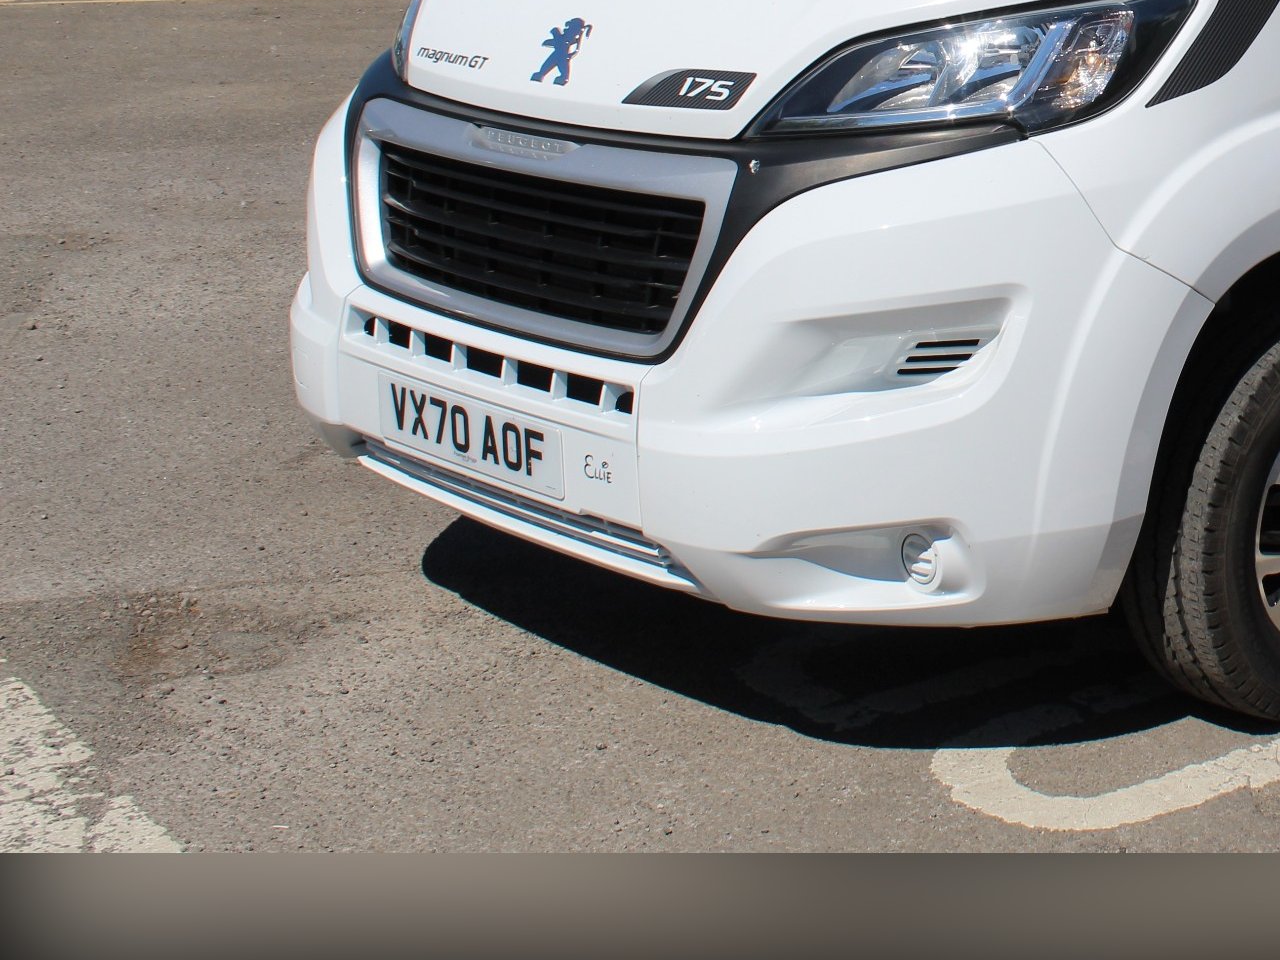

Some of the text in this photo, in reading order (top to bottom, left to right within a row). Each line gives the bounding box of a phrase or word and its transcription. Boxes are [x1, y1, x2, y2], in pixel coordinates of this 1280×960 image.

[678, 76, 735, 101] 175
[390, 382, 545, 476] VX70 AOF
